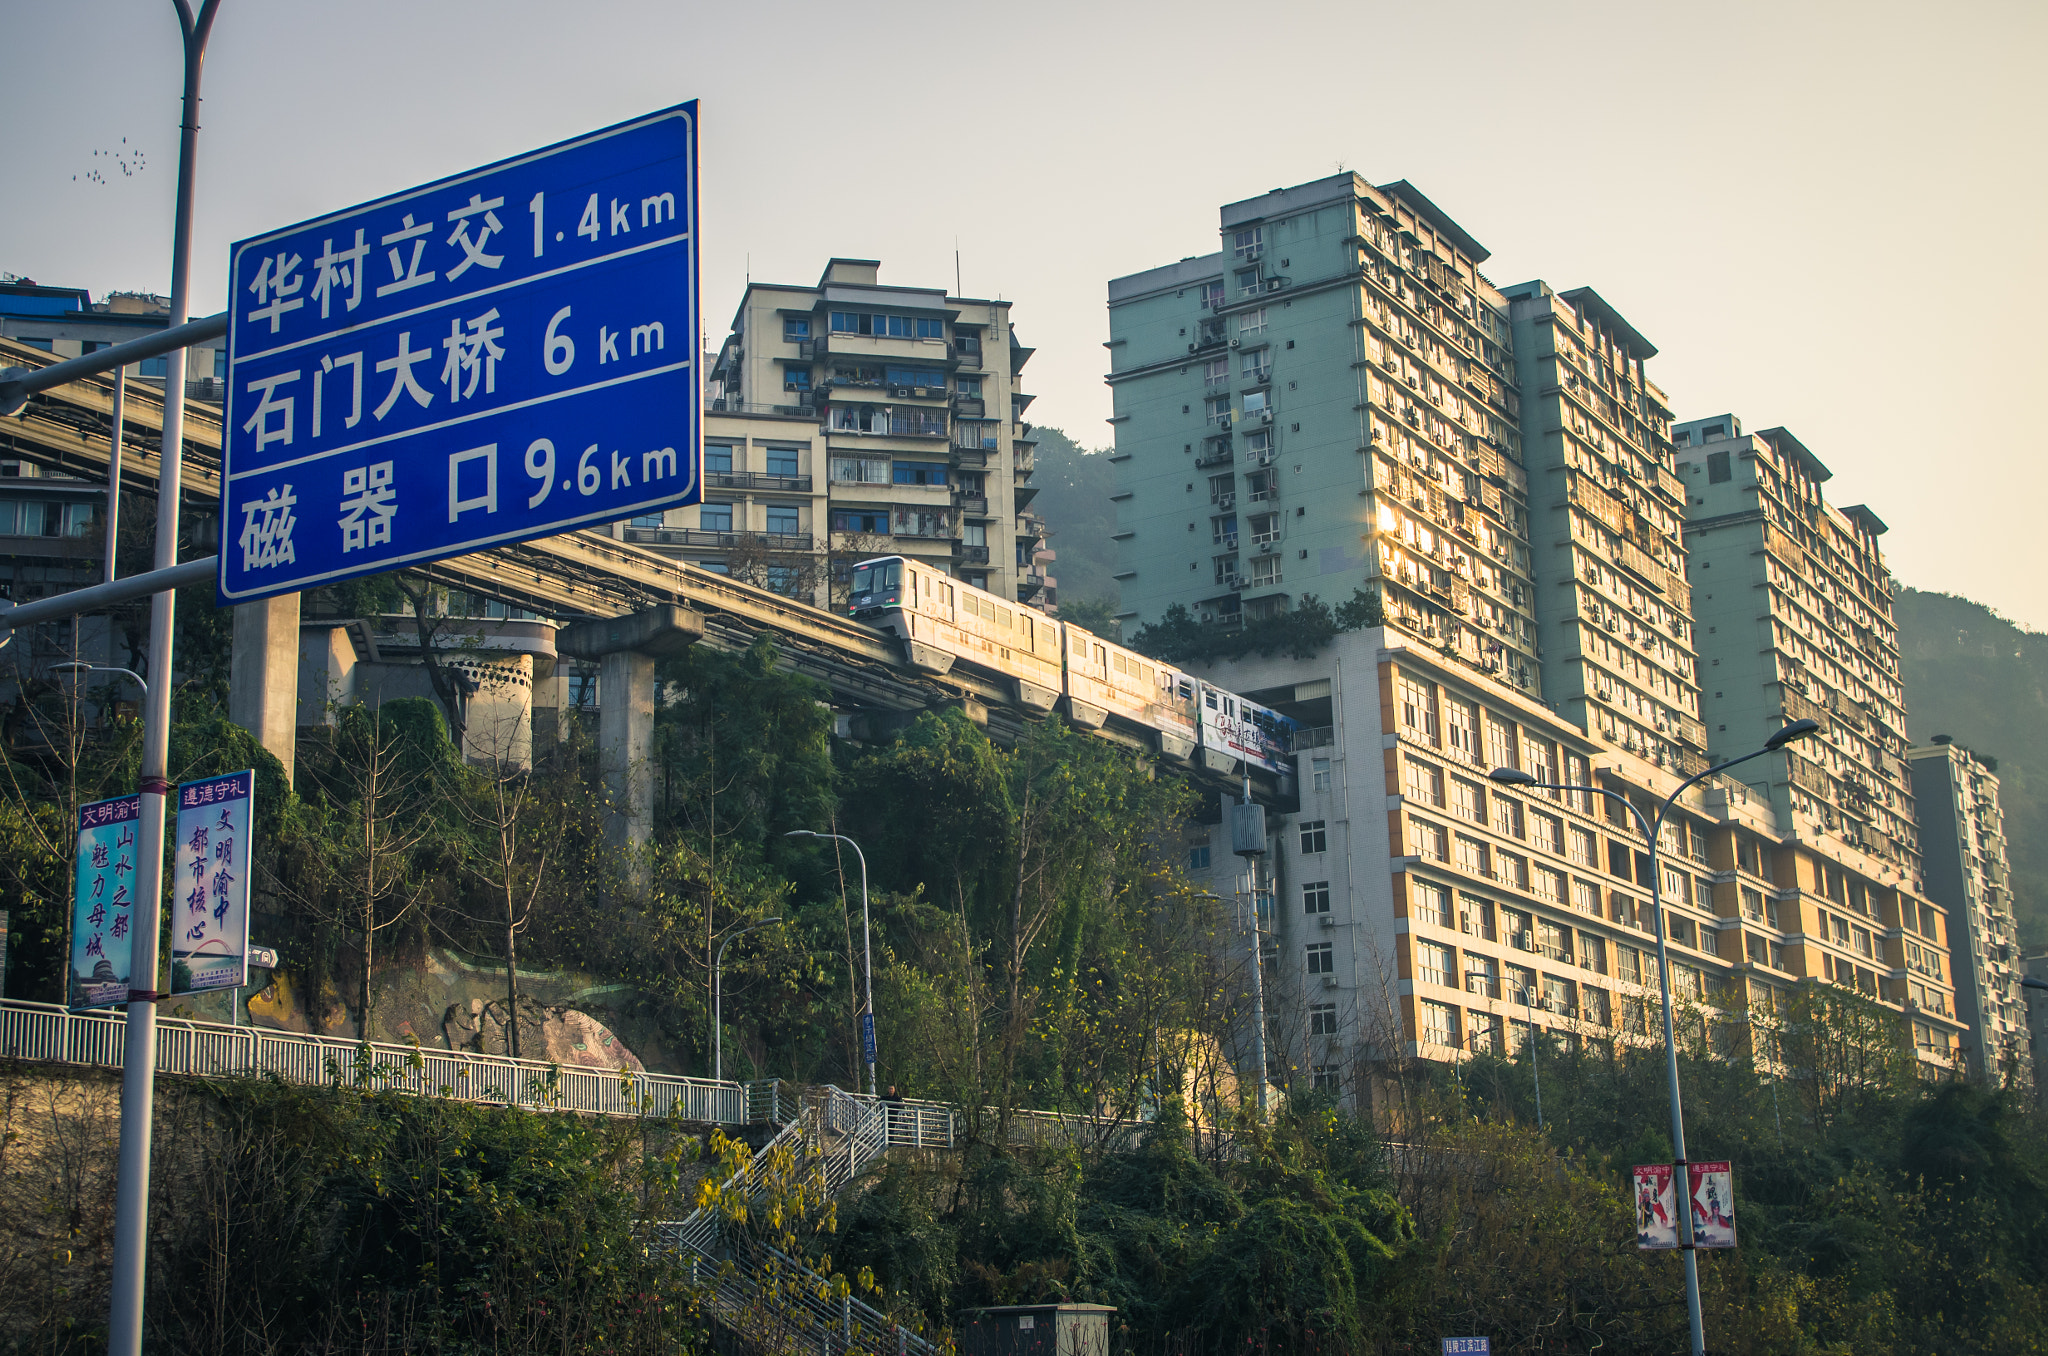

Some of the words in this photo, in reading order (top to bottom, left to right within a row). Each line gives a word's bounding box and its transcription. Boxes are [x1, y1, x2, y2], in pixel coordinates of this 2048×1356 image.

[248, 193, 505, 334] 华村立交
[243, 307, 506, 453] 石门大桥
[543, 305, 576, 376] 6
[599, 320, 665, 365] km
[239, 442, 498, 573] 磁器口
[85, 843, 110, 960] 魅力母城
[109, 825, 134, 941] 山水之都
[186, 826, 209, 942] 都市核心
[212, 808, 235, 932] 文明渝中
